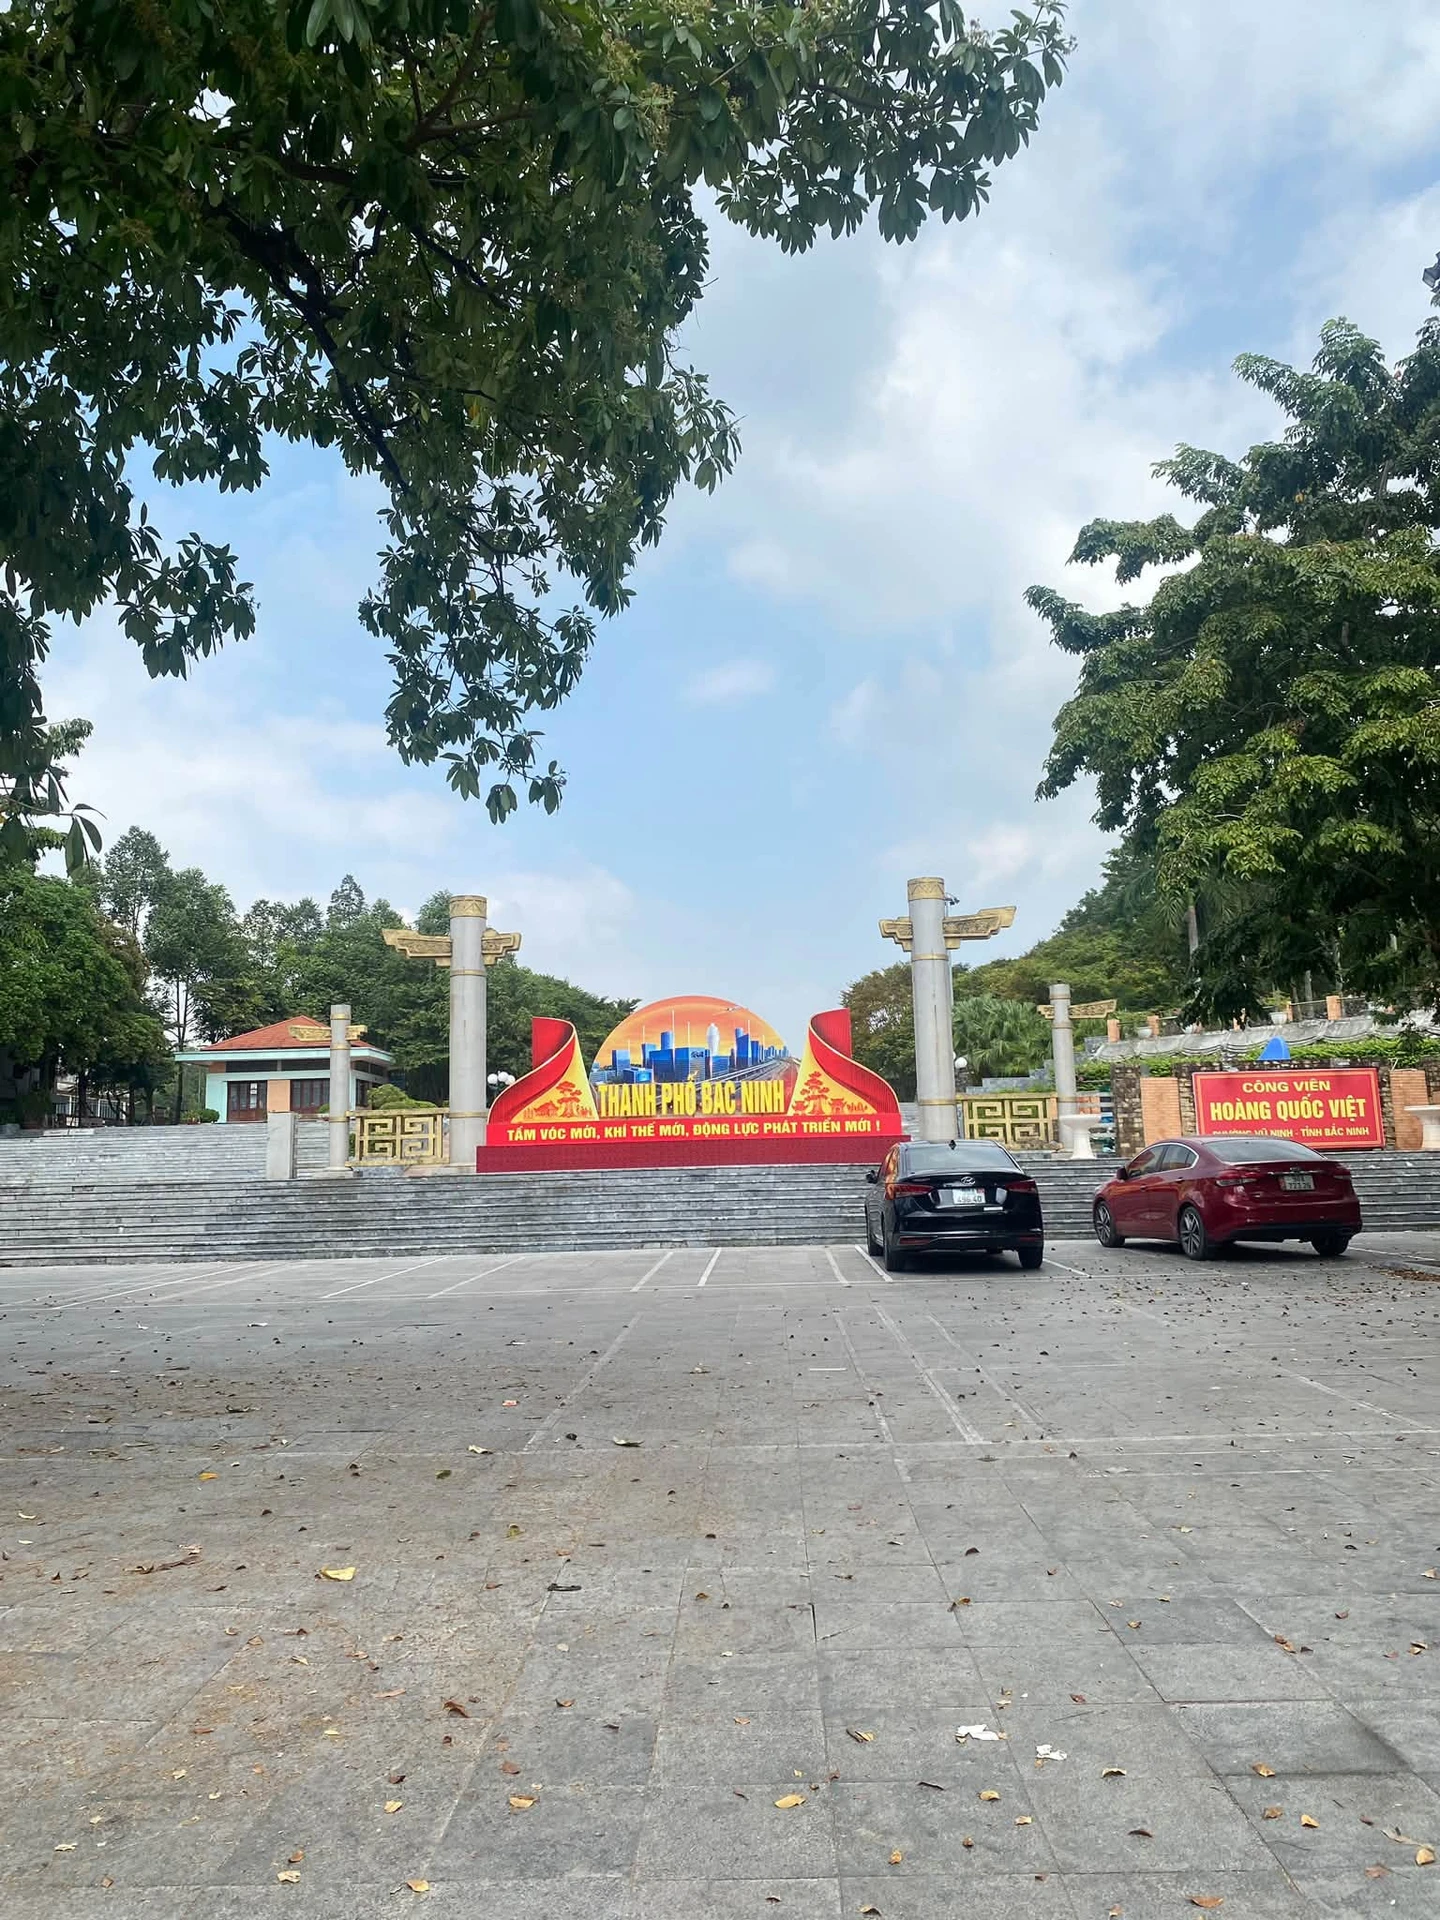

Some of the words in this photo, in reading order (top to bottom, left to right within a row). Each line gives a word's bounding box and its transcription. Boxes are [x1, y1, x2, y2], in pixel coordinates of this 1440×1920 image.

[741, 1079, 785, 1113] NINH
[1242, 1079, 1289, 1093] CÔNG
[1293, 1078, 1331, 1092] VIÊN
[1210, 1098, 1272, 1121] HOÀNG
[1276, 1093, 1324, 1122] QUỐC
[1329, 1095, 1366, 1122] VIỆT
[540, 1126, 566, 1140] VÓC
[570, 1124, 600, 1140] MỚI,
[604, 1124, 627, 1138] KHÍ
[630, 1121, 655, 1137] THẾ
[659, 1122, 689, 1137] MỚI,
[693, 1121, 730, 1138] ĐỘNG
[734, 1121, 759, 1137] LỰC
[763, 1119, 798, 1134] PHÁT
[802, 1117, 841, 1133] TRIỂN
[845, 1117, 871, 1132] MỚI
[1301, 1125, 1322, 1137] TỈNH
[1325, 1123, 1344, 1136] BẮC
[1346, 1126, 1369, 1136] NINH
